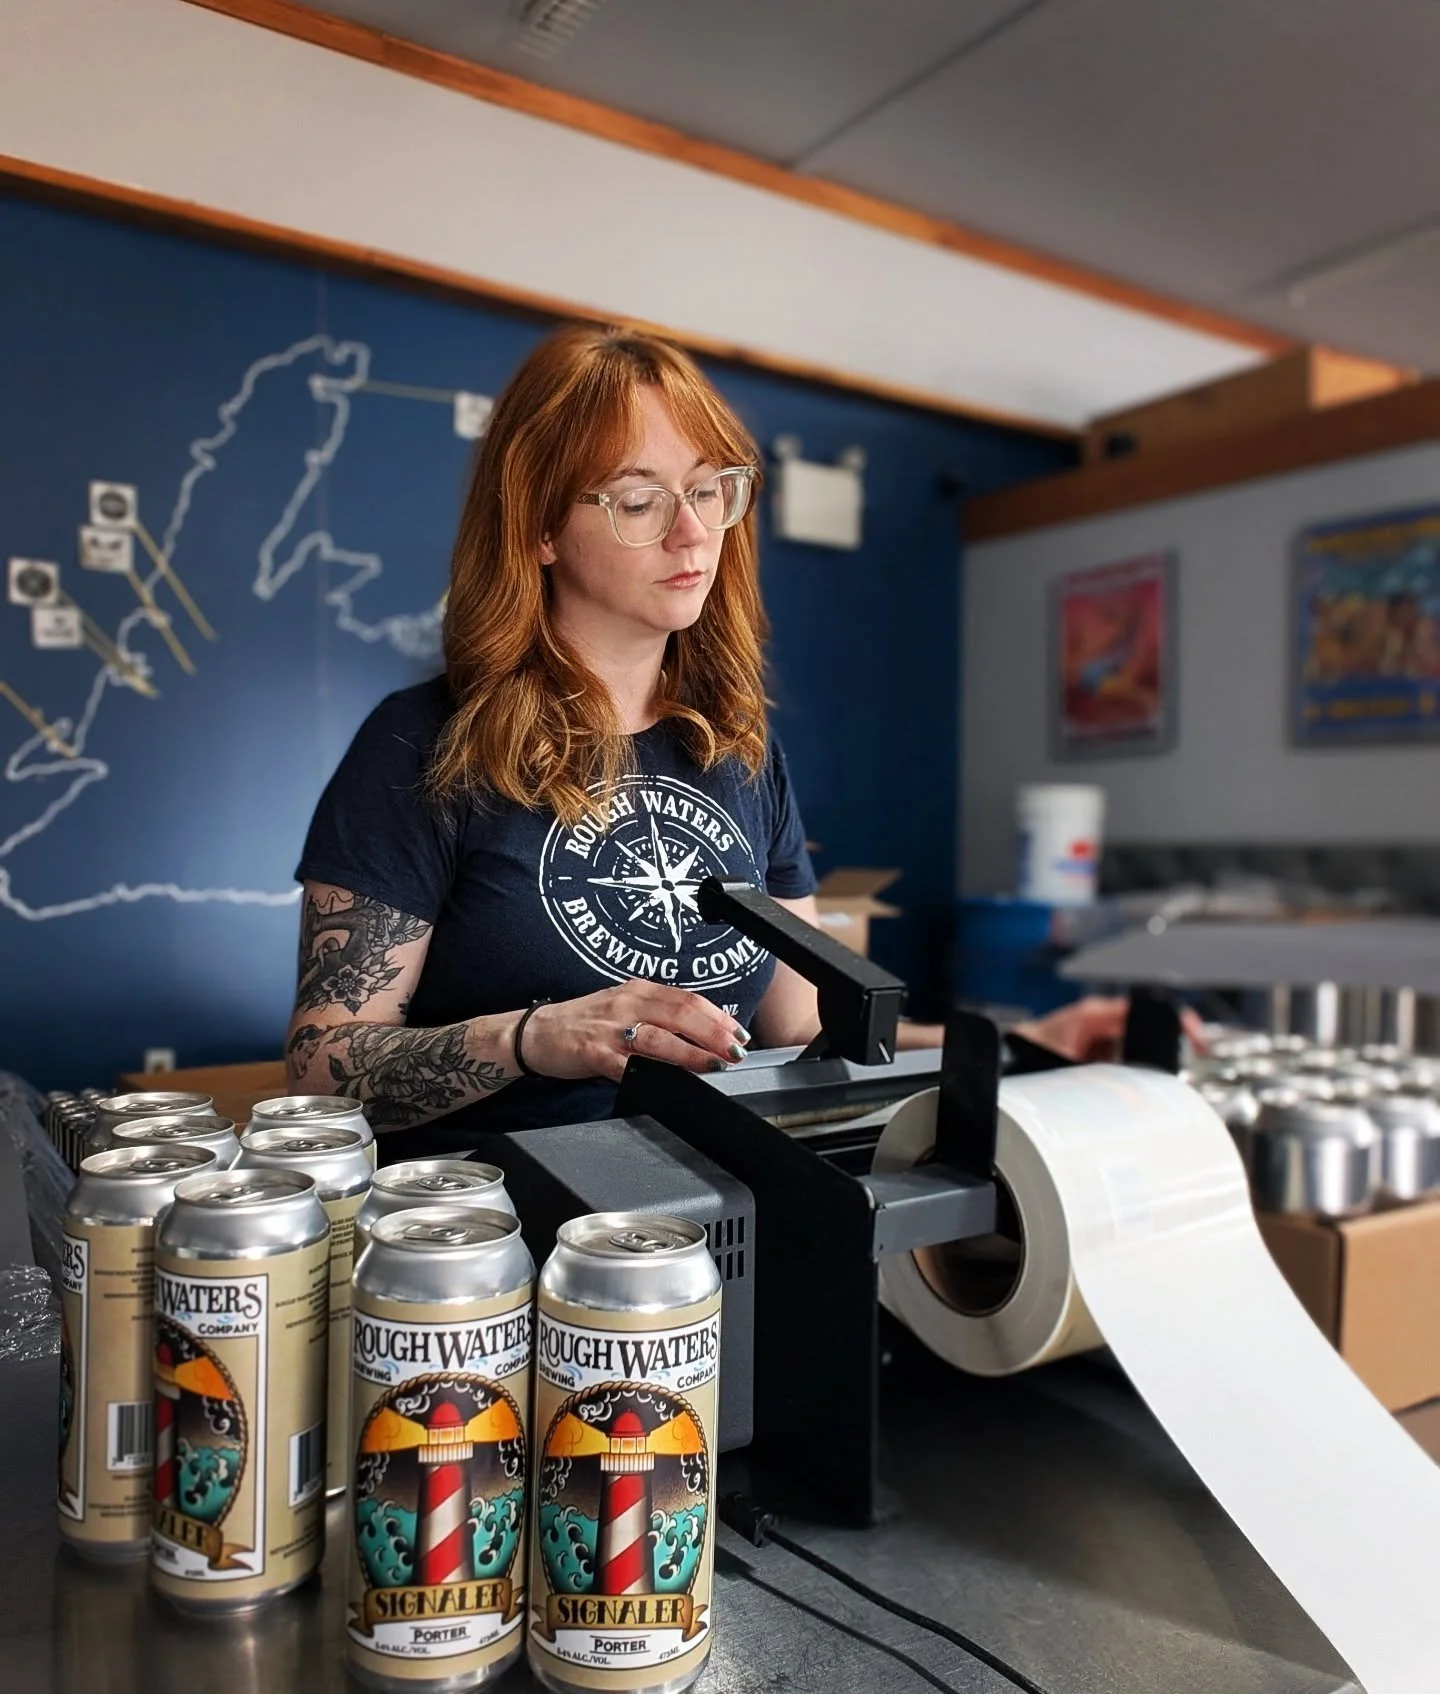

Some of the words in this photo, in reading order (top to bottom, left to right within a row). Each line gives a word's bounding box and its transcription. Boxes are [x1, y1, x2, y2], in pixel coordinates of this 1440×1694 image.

[565, 791, 636, 860] ROUGH
[640, 790, 734, 852] WATERS
[562, 896, 678, 979] BREWING
[161, 1277, 262, 1319] WATERS
[198, 1321, 259, 1335] COMPANY
[354, 1316, 431, 1364] ROUGH
[434, 1307, 534, 1369] WATERS
[539, 1318, 614, 1371] ROUGH
[617, 1320, 718, 1379] WATERS
[677, 1365, 717, 1389] COMPANY
[375, 1583, 505, 1618] SIGNALER
[557, 1597, 686, 1625] SIGNALER
[414, 1626, 468, 1642] PORTER
[594, 1638, 647, 1652] PORTER
